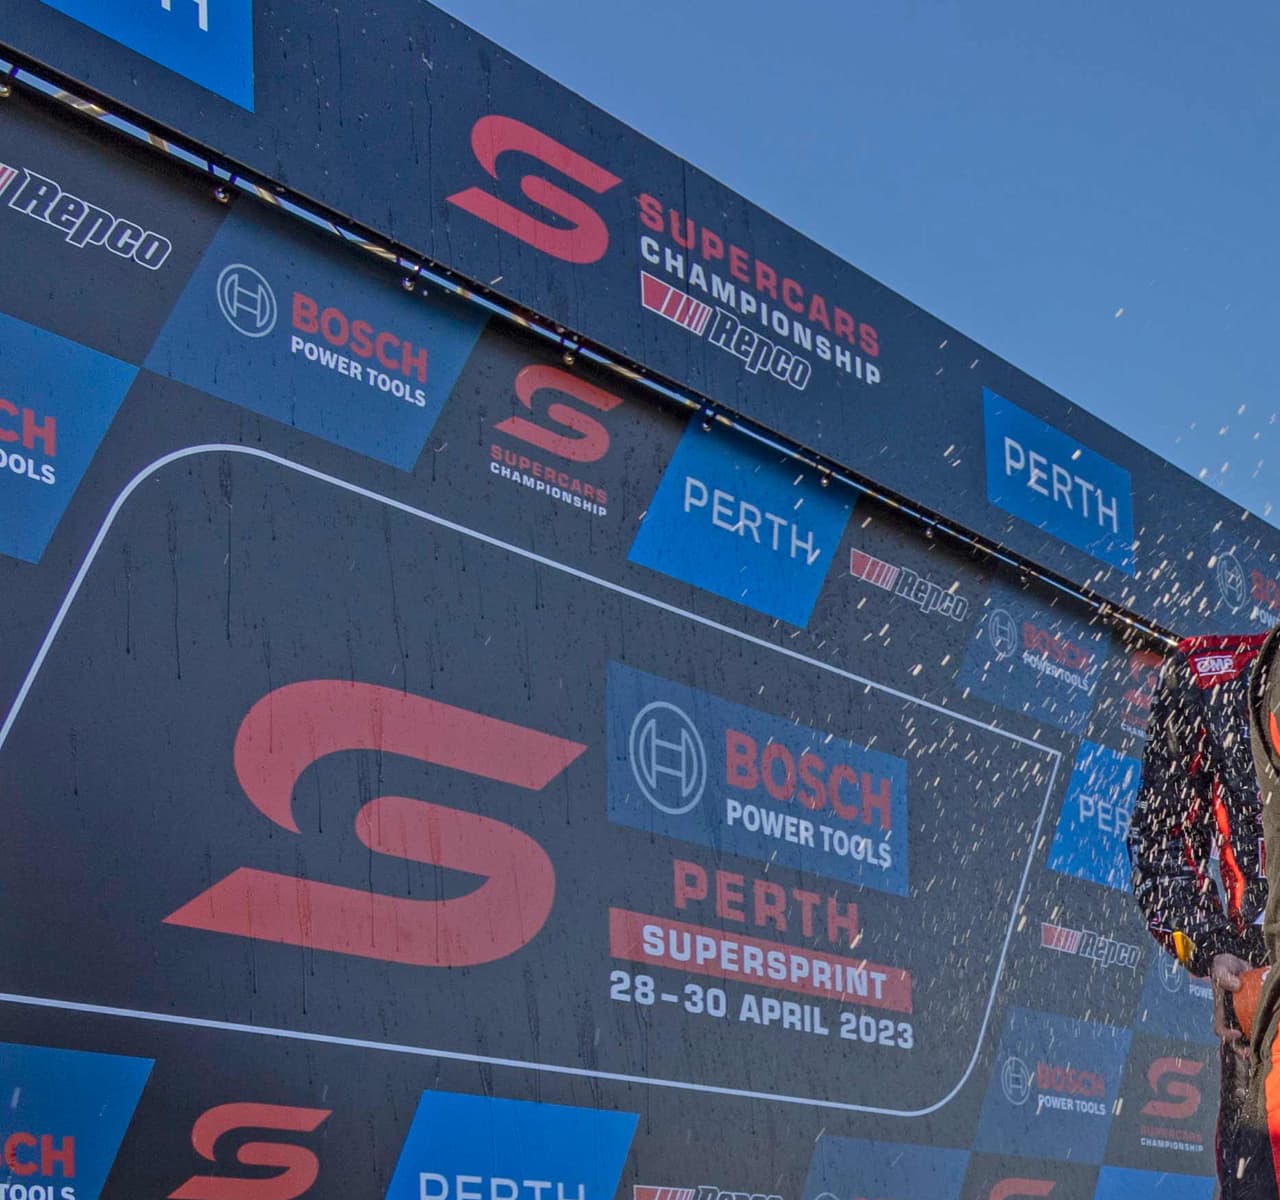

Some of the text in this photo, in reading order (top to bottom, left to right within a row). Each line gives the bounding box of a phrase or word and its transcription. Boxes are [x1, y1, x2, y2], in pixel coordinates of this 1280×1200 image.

[10, 168, 172, 270] Repco
[639, 193, 880, 357] SUPERCARS
[292, 291, 430, 385] BOSCH
[640, 236, 882, 386] CHAMPIONSHIP
[291, 335, 427, 408] POWER TOOLS
[708, 305, 813, 391] Repco
[0, 448, 56, 485] OLS
[490, 444, 608, 504] SUPERCARS
[490, 462, 608, 517] CHAMPIONSHIP
[1005, 435, 1119, 535] PERTH
[683, 478, 820, 566] PERTH
[1024, 622, 1090, 672] BOSCH
[1055, 662, 1089, 690] TOOLS
[1197, 656, 1233, 672] OMP
[725, 729, 892, 829] BOSCH
[726, 799, 893, 869] POWER TOOLS
[1079, 794, 1132, 841] PER
[672, 859, 859, 946] PERTH
[641, 924, 888, 1000] SUPERSPRINT
[739, 995, 829, 1036] APRIL
[840, 1012, 914, 1050] 2023
[1036, 1061, 1105, 1098] BOSCH
[1038, 1094, 1106, 1116] POWER TOOLS
[1140, 1137, 1204, 1152] CHAMPIONSHIP
